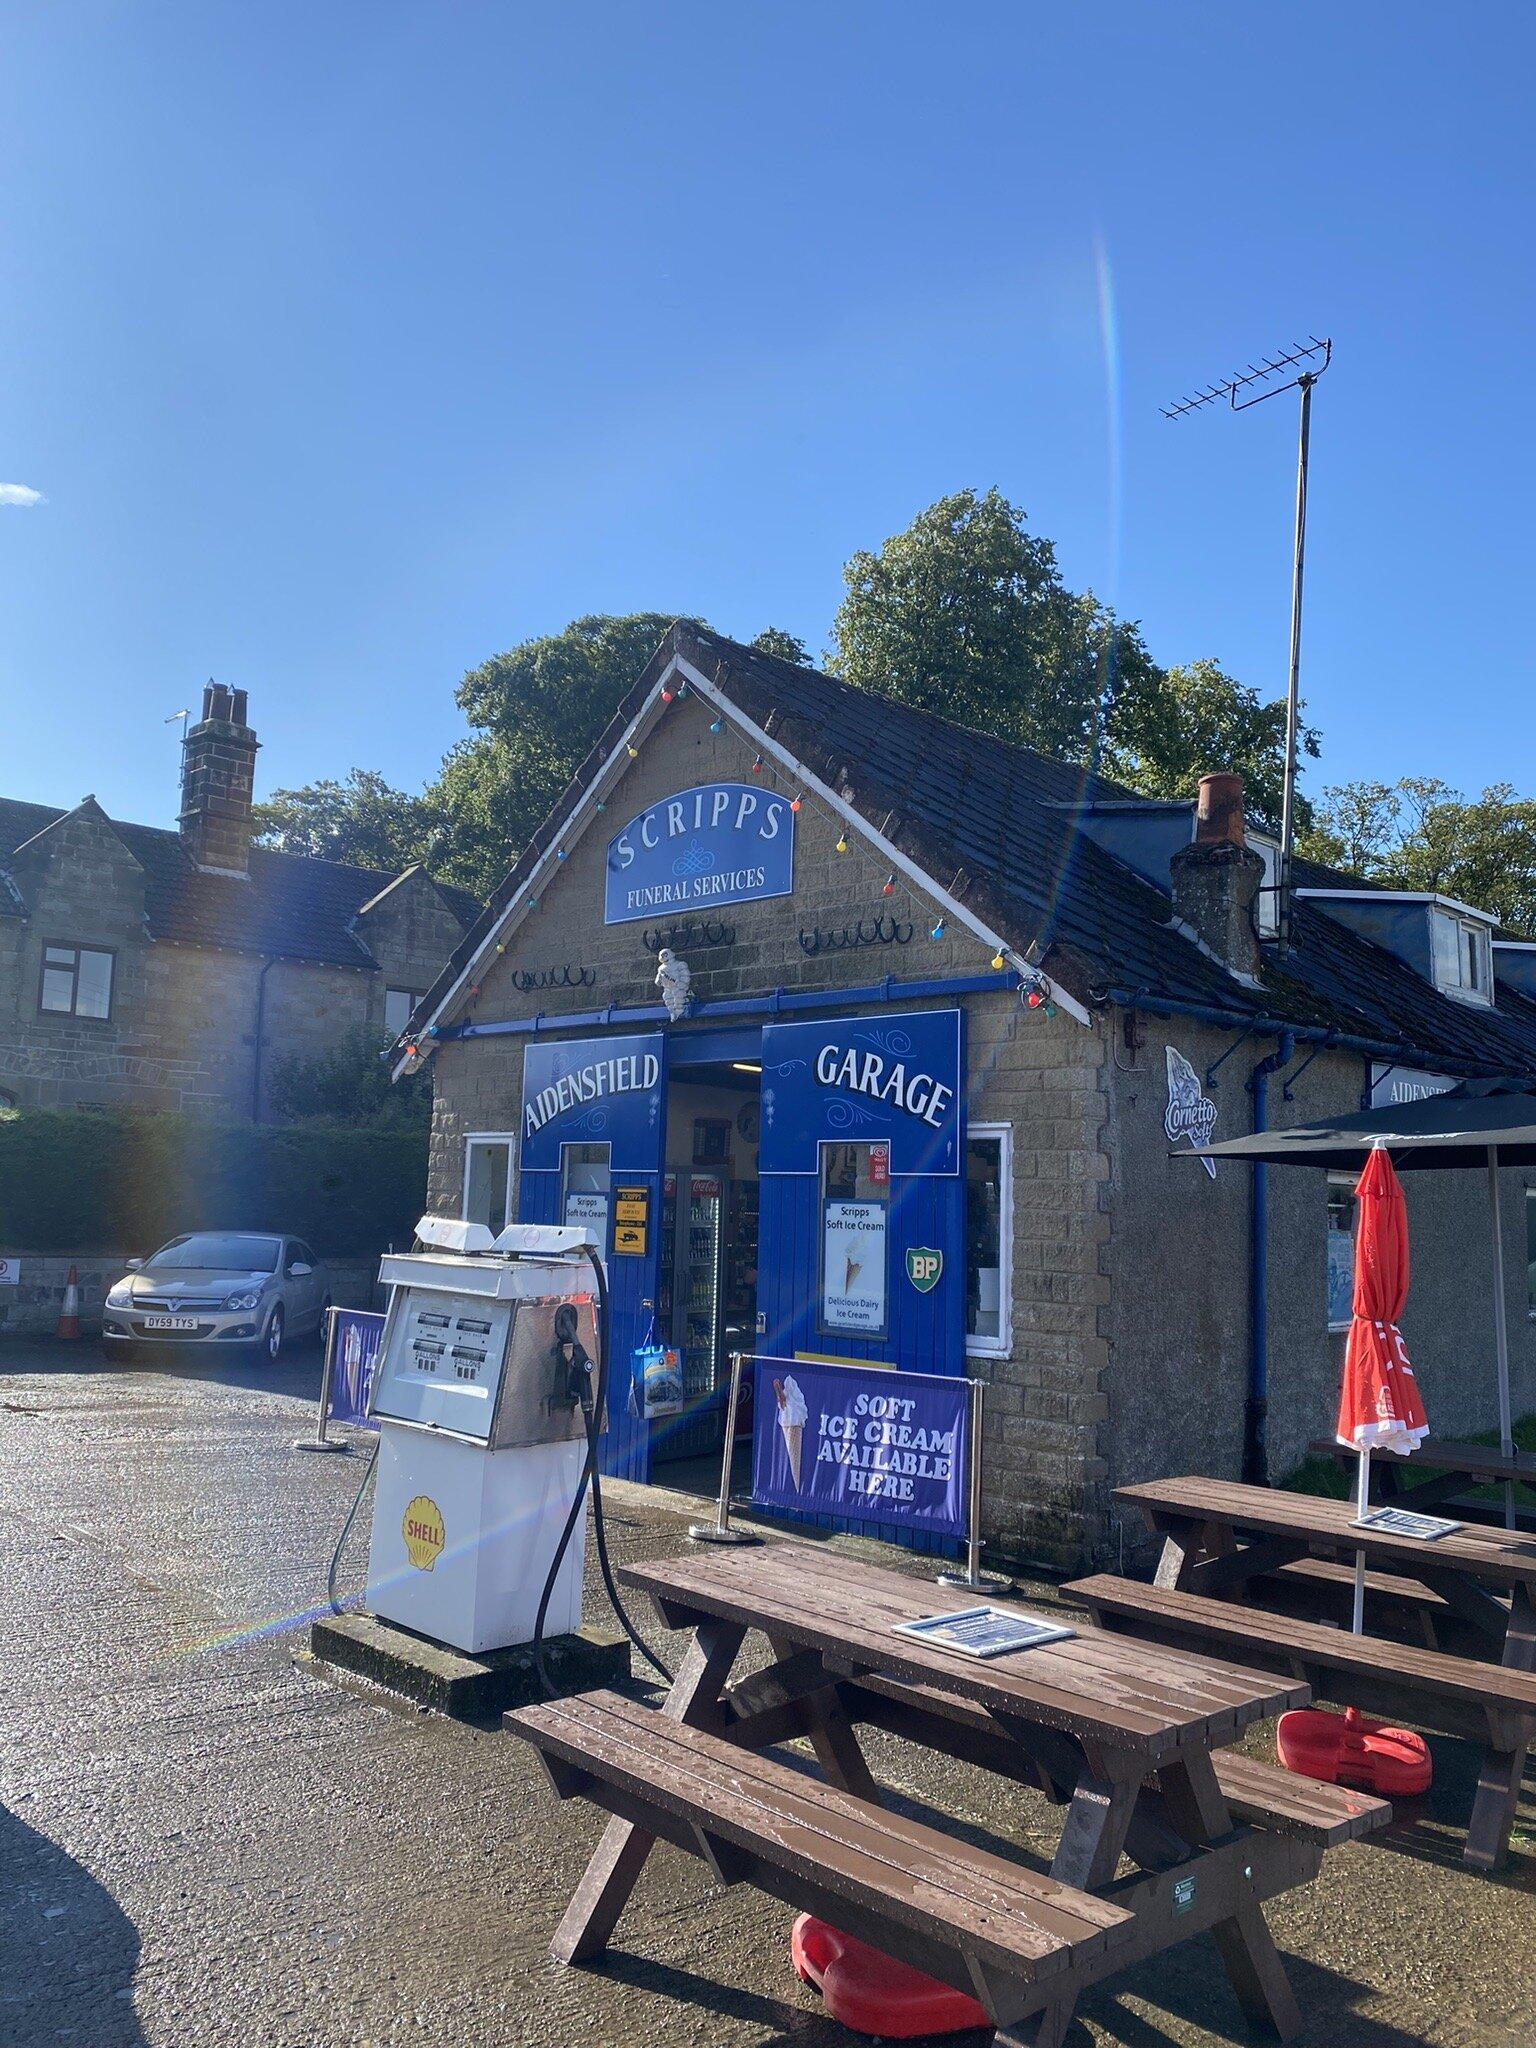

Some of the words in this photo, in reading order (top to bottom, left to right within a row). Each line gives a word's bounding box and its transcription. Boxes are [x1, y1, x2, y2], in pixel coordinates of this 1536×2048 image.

[616, 791, 783, 869] SCRIPPS
[626, 880, 691, 909] FUNERAL
[693, 866, 765, 897] SERVICES
[525, 1054, 659, 1138] AIDENSFIELD
[817, 1044, 953, 1128] GARAGE
[1168, 1100, 1213, 1133] Cornetto
[567, 1208, 579, 1217] Soft
[588, 1209, 606, 1218] Cream
[577, 1197, 597, 1208] Scripps
[841, 1207, 869, 1217] Scripps
[827, 1221, 843, 1229] Soft
[845, 1221, 856, 1230] Ice
[858, 1221, 884, 1231] Cream
[911, 1255, 938, 1279] BP
[828, 1297, 859, 1307] Delicious
[861, 1299, 879, 1311] Dairy
[836, 1309, 846, 1317] Ice
[847, 1310, 870, 1319] Cream
[149, 1317, 172, 1327] DY59
[175, 1319, 193, 1328] TYS
[854, 1394, 916, 1421] SOFT
[818, 1414, 858, 1440] ICE
[864, 1421, 953, 1454] CREAM
[817, 1440, 952, 1480] AVAILABLE
[848, 1470, 915, 1501] HERE
[408, 1519, 440, 1546] SHELL
